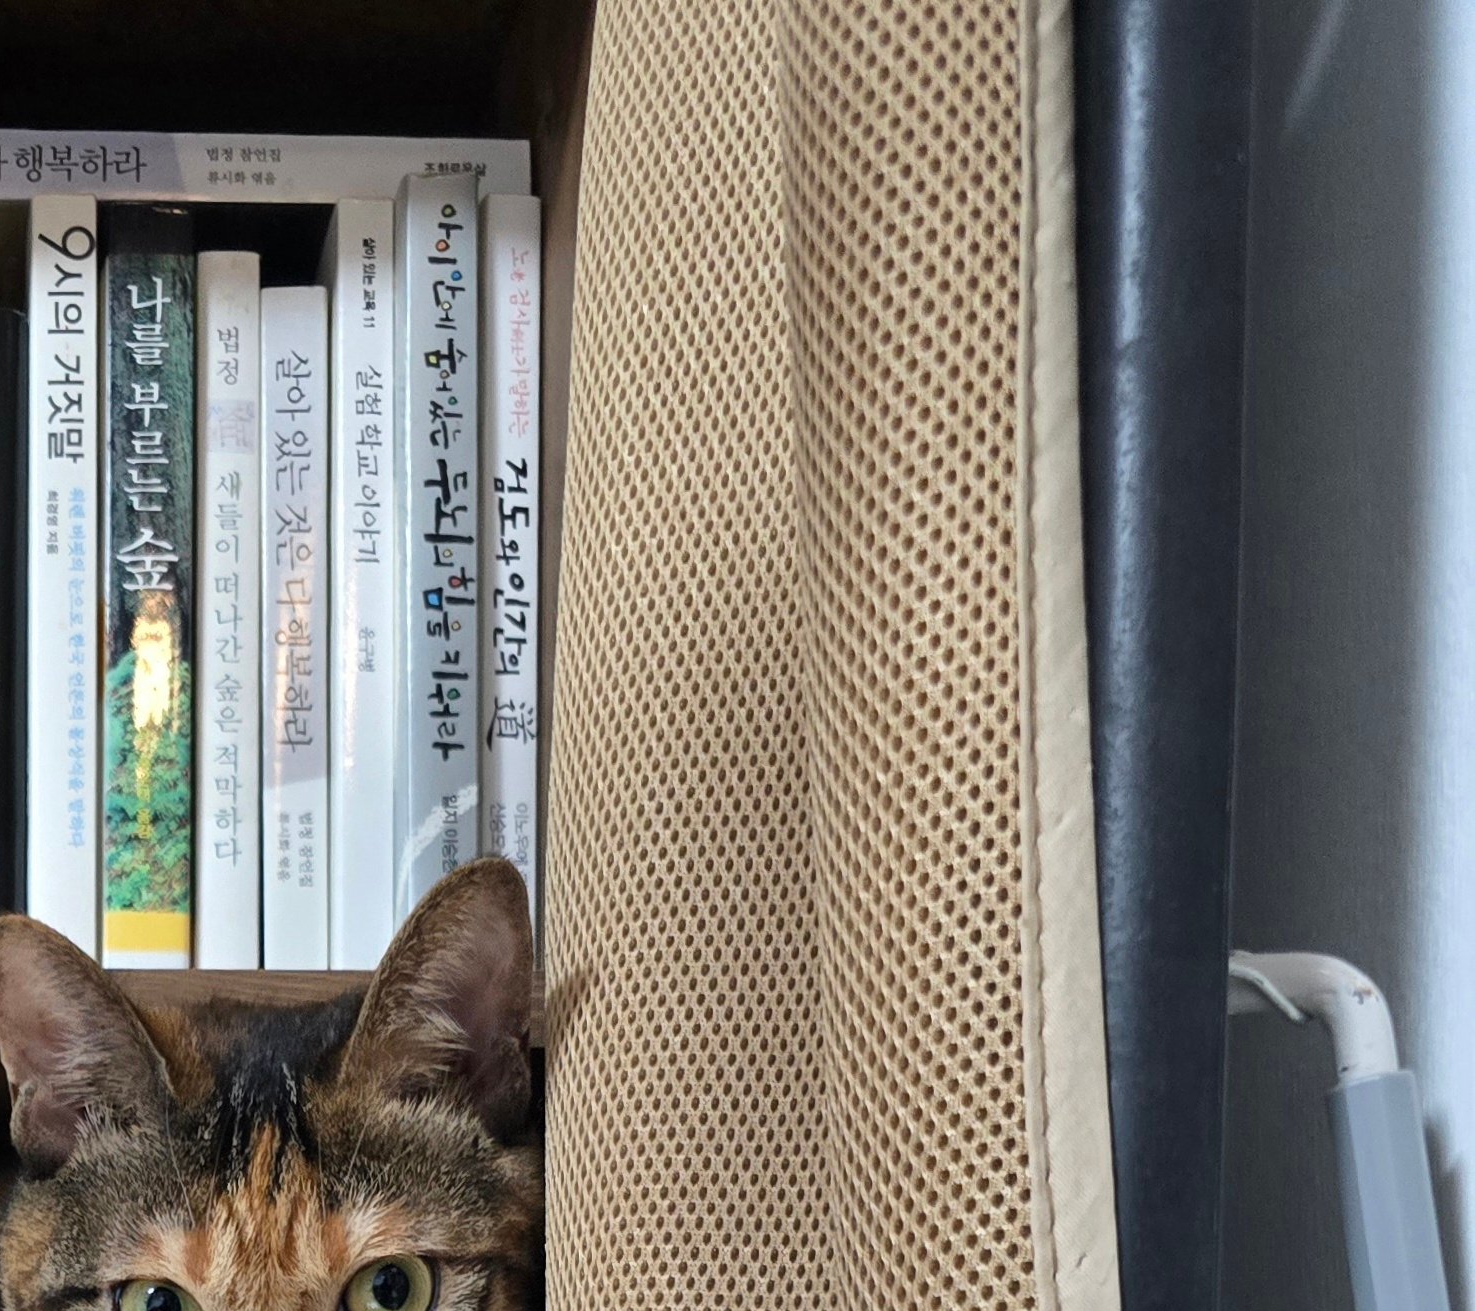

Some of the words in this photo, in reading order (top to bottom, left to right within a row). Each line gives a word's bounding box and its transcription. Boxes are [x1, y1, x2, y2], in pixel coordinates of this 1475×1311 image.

[14, 146, 148, 184] 행복하라
[38, 225, 96, 335] 9시의
[125, 276, 171, 366] 나를
[48, 354, 85, 464] 거짓말
[275, 350, 311, 421] 살아
[355, 364, 383, 417] 실험
[124, 382, 171, 512] 부르는
[275, 431, 311, 496] 있는
[355, 424, 383, 477] 학교
[215, 472, 243, 563] 새들이
[276, 504, 312, 568] 것은
[355, 485, 383, 564] 이야기
[424, 459, 475, 566] 두뇌의
[493, 457, 531, 566] 검도와
[117, 528, 179, 591] 숲
[215, 573, 243, 664] 떠나간
[492, 573, 531, 676] 인간의
[215, 674, 243, 734] 숲은
[275, 619, 313, 753] 행복하라
[428, 651, 470, 762] 키워라
[215, 744, 243, 868] 적막하다
